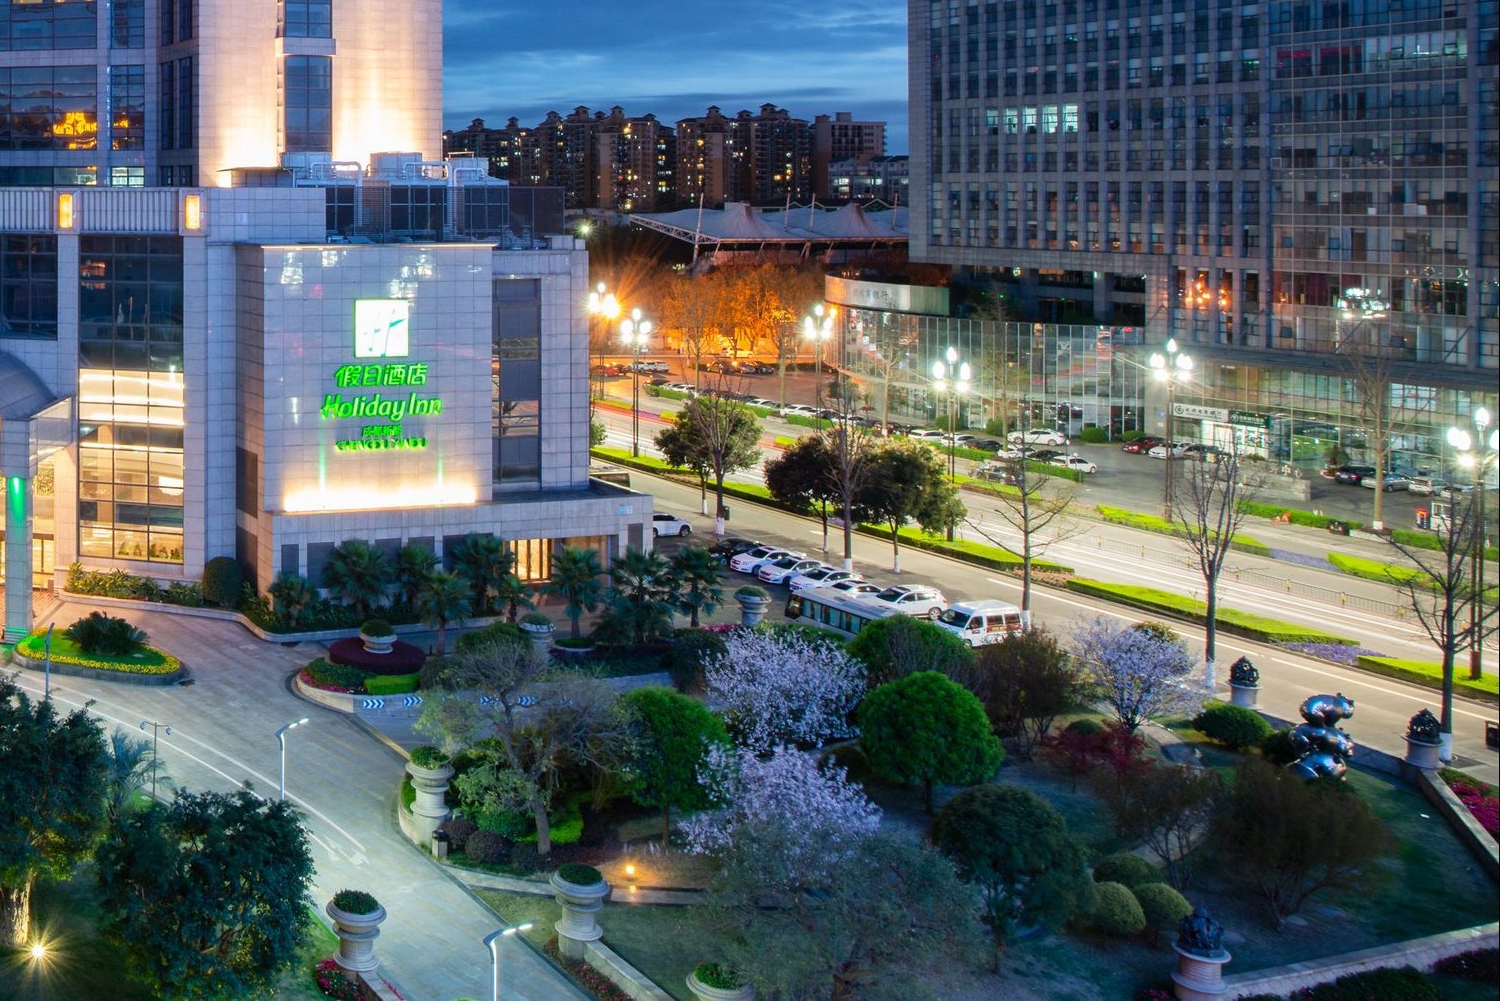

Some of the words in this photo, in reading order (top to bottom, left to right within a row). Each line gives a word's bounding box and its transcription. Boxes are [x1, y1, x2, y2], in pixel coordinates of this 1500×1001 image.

[334, 363, 429, 387] 假日酒店
[320, 394, 406, 421] Holiday
[407, 393, 443, 416] Inn
